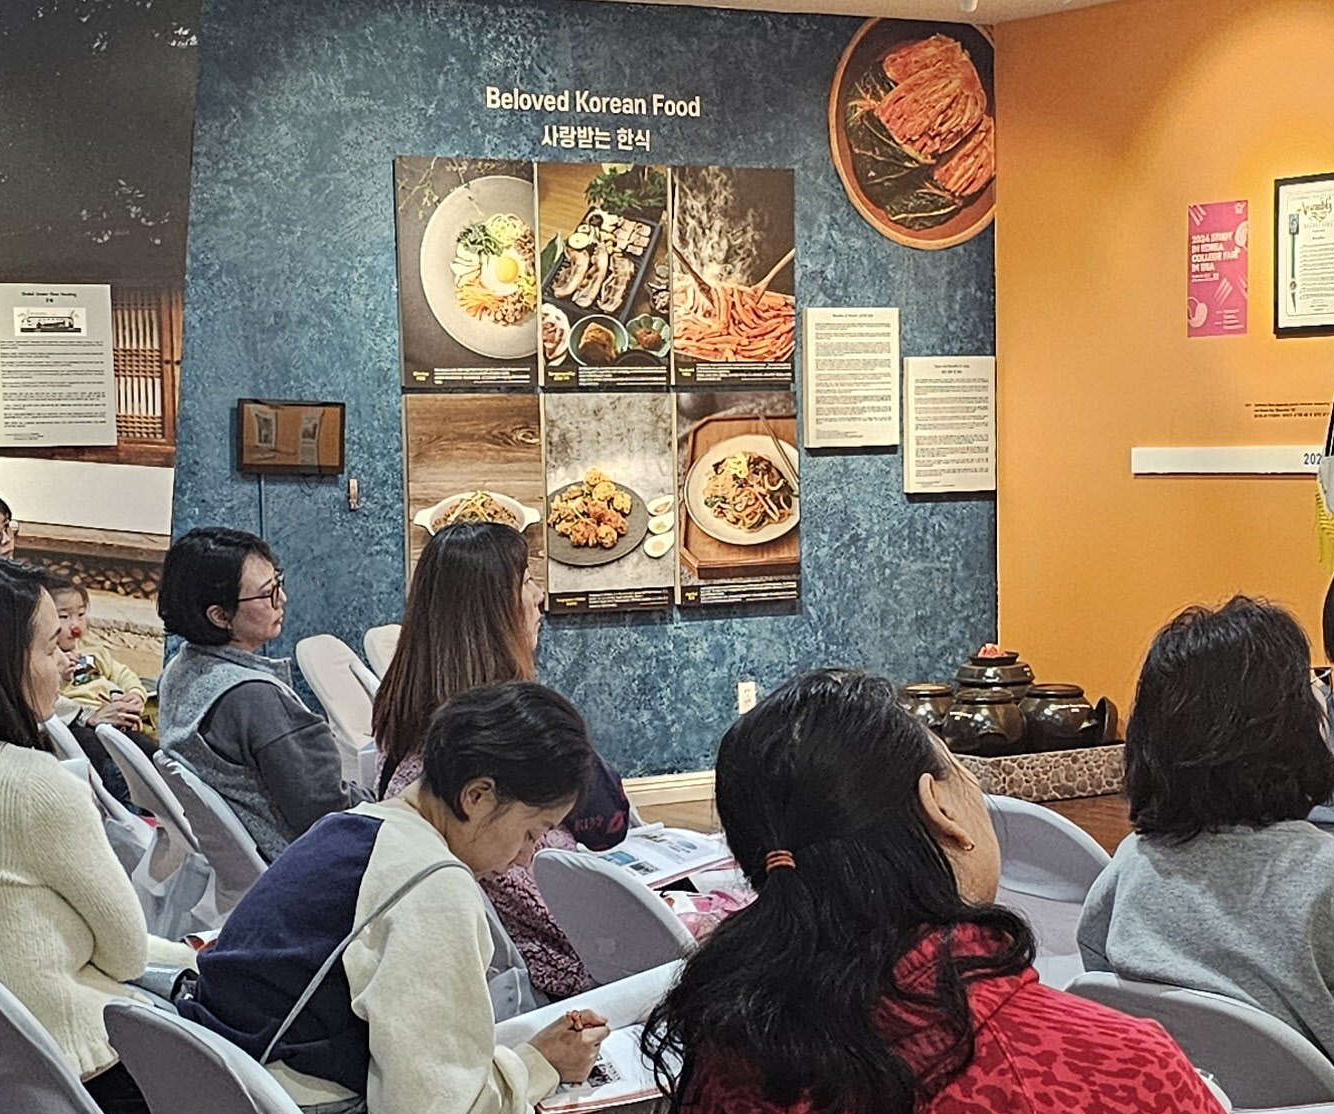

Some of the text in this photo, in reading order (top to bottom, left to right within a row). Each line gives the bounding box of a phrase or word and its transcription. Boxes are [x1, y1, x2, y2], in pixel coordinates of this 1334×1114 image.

[486, 86, 701, 117] Beloved Korean Food
[540, 125, 651, 151] 사랑받는 한식
[1211, 231, 1235, 243] STUDY
[1191, 242, 1224, 254] IN KOREA
[1191, 252, 1223, 263] COLLEGE
[1191, 263, 1200, 273] IN
[1303, 452, 1323, 465] 202
